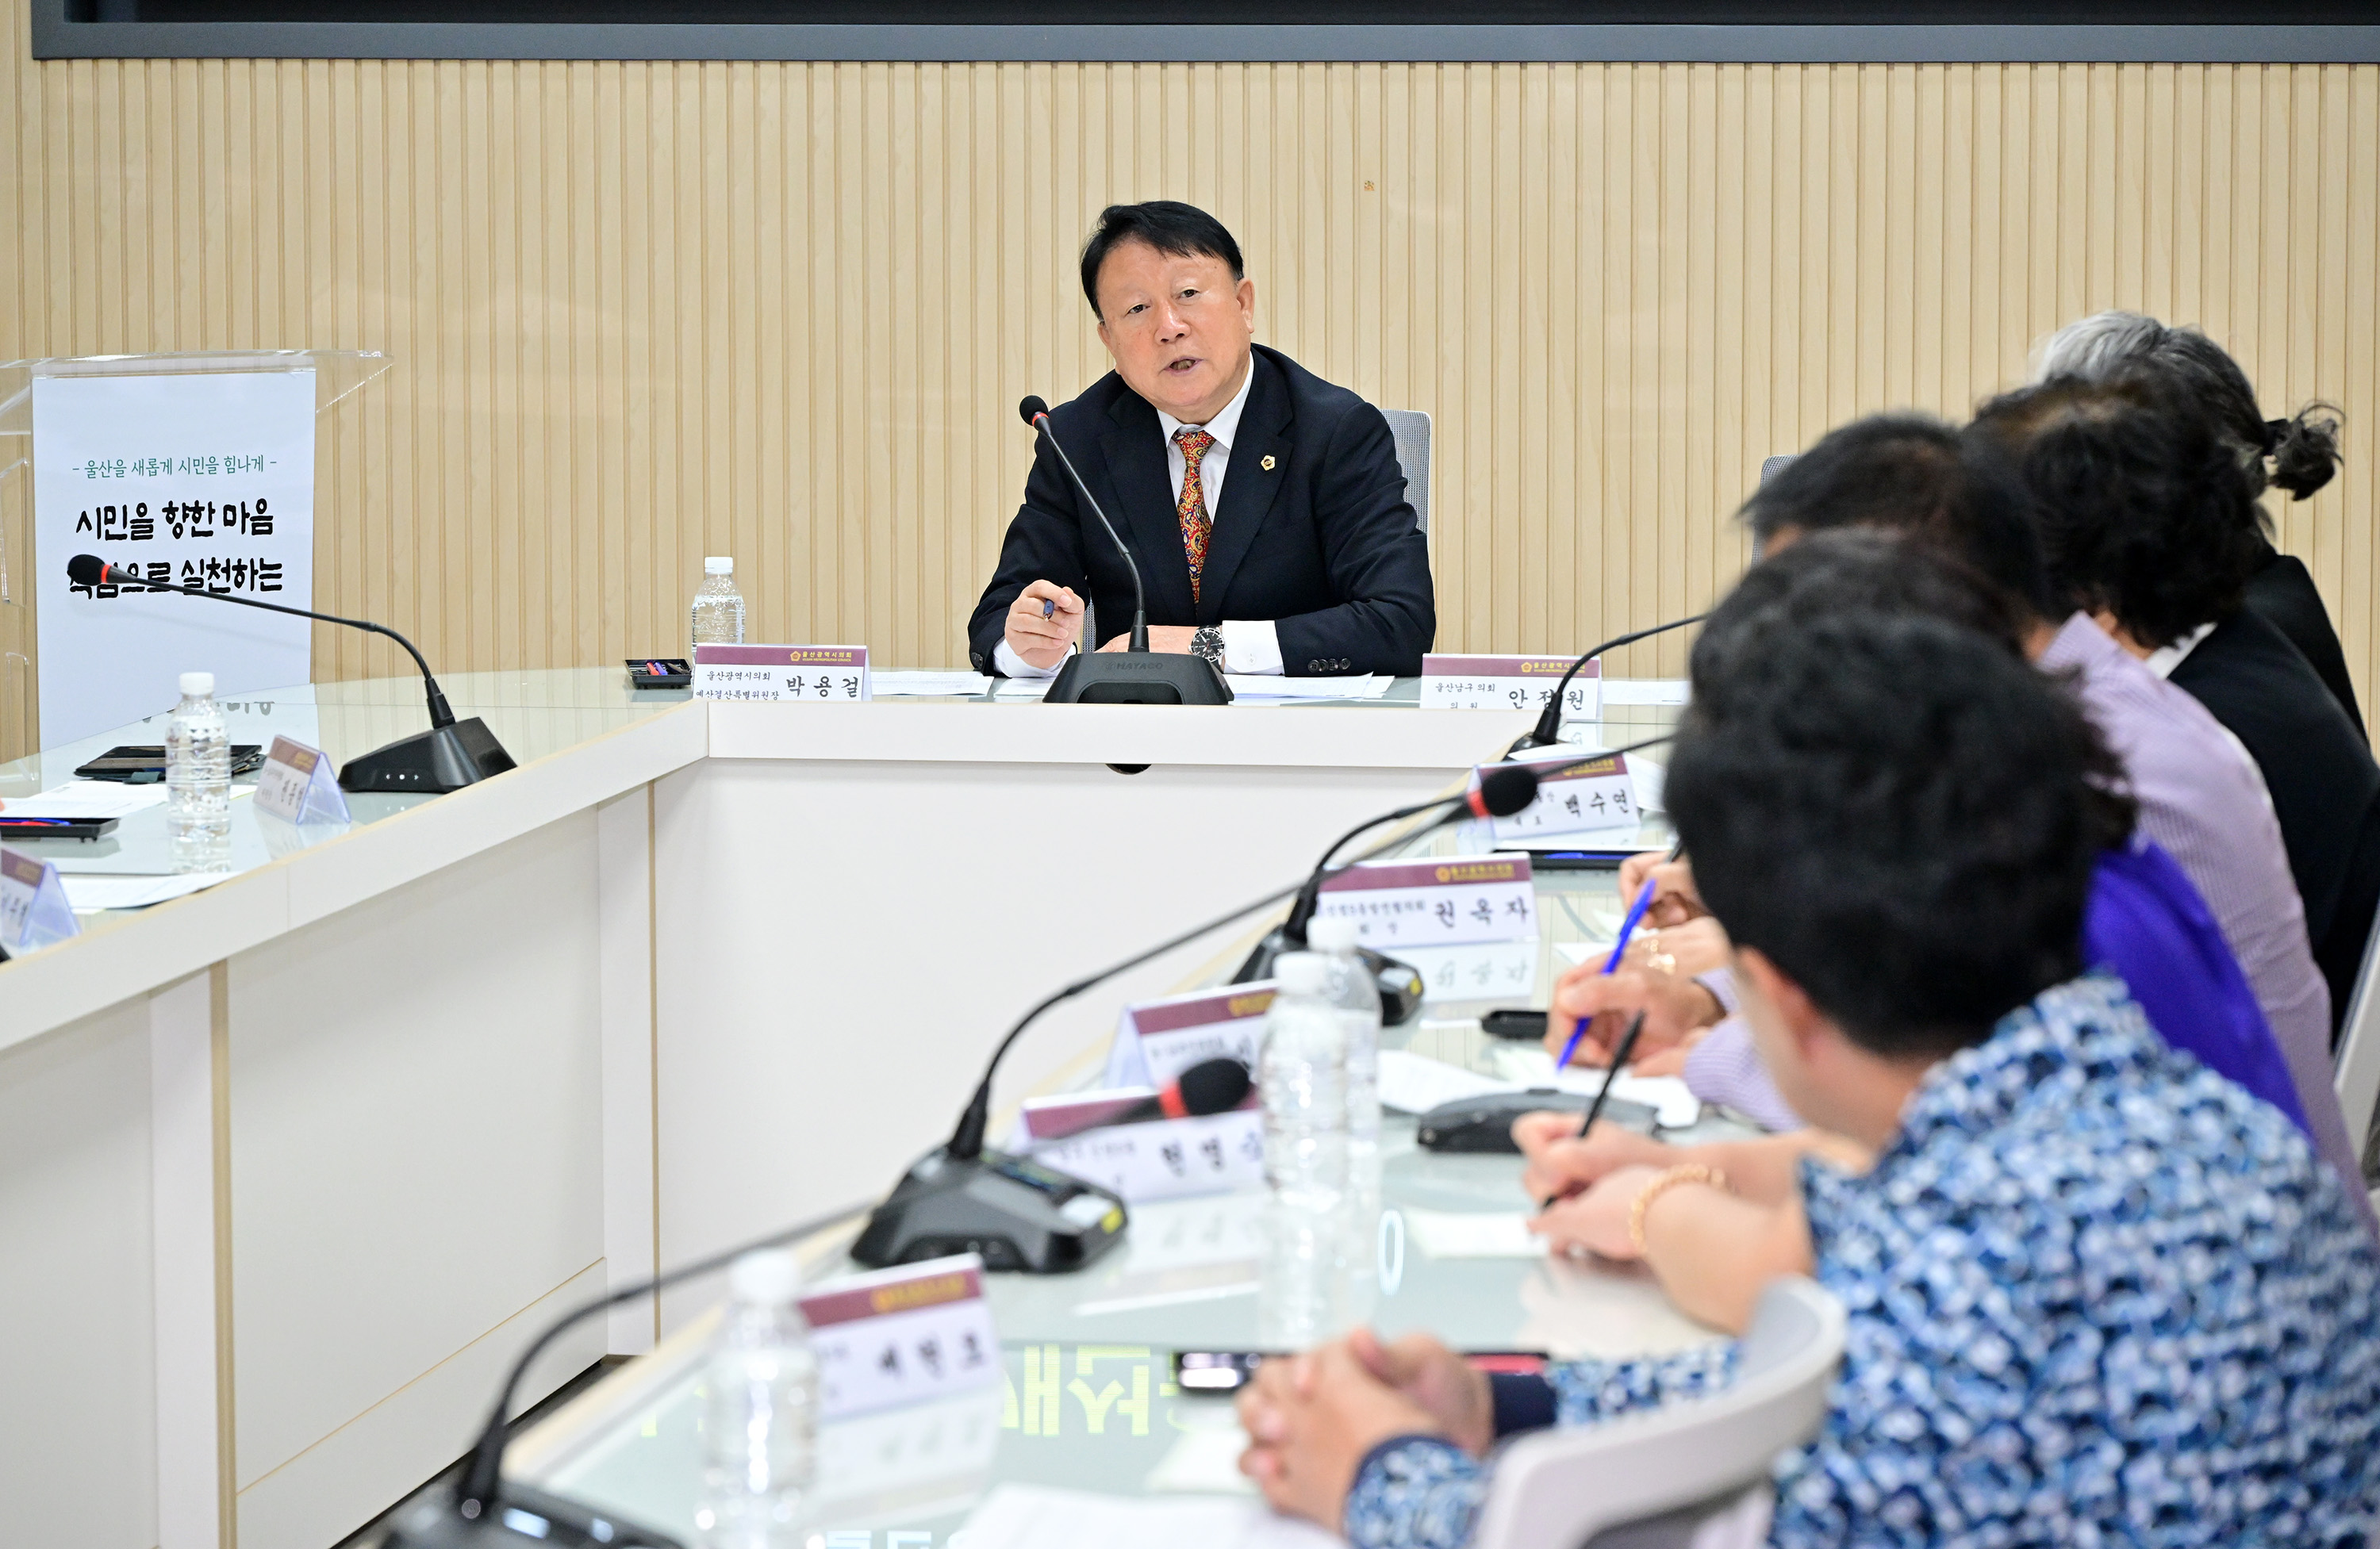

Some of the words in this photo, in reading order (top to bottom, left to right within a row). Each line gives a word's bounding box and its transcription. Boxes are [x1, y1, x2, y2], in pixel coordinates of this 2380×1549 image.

[84, 458, 127, 479] 울산을
[131, 457, 174, 477] 새롭게
[178, 455, 220, 476] 시민을
[223, 454, 265, 475] 힘나게
[76, 502, 155, 542] 시민을
[161, 499, 217, 540] 향한
[222, 497, 274, 536] 마음
[180, 557, 283, 597] 실천하는
[706, 670, 771, 681] 울산광역시의회
[696, 689, 780, 701] 예산결산특별위원장
[1435, 682, 1474, 693] 울산남구
[1477, 683, 1496, 692] 의회
